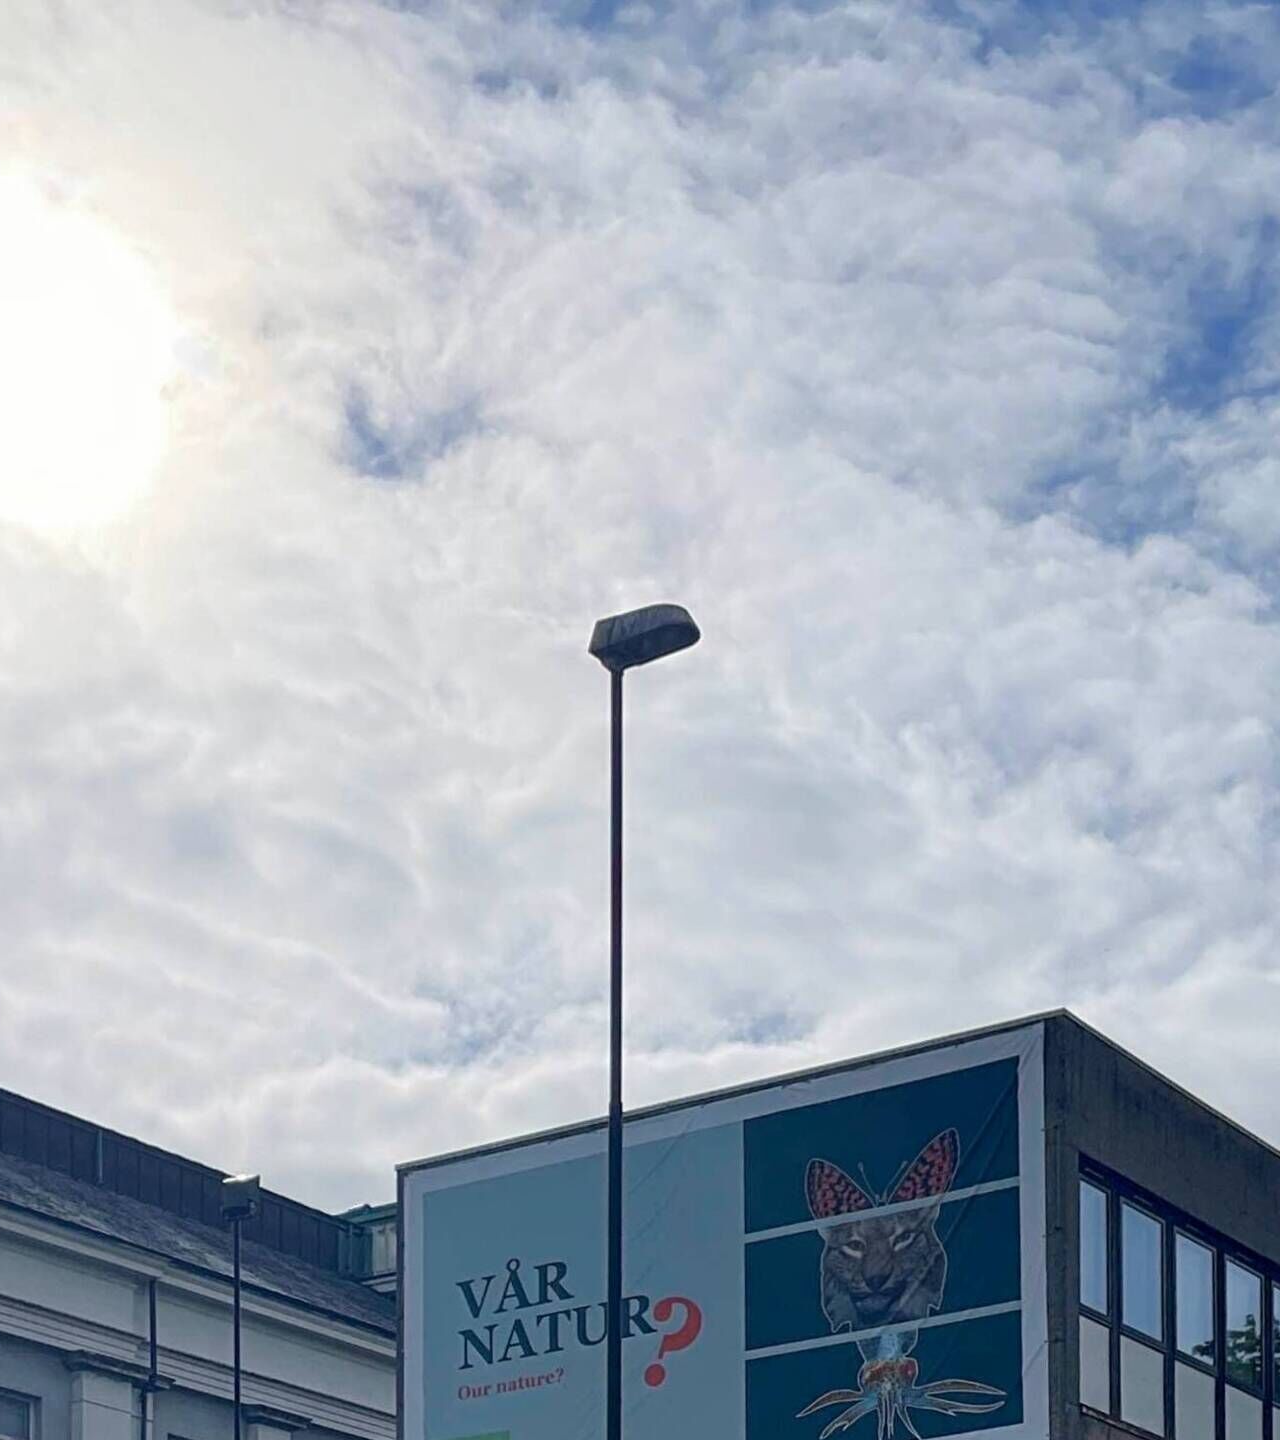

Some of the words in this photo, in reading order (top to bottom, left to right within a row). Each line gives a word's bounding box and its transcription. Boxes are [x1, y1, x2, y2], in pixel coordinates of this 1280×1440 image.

[456, 1258, 574, 1319] VÅR
[458, 1382, 492, 1402] Our
[496, 1367, 565, 1395] nature?
